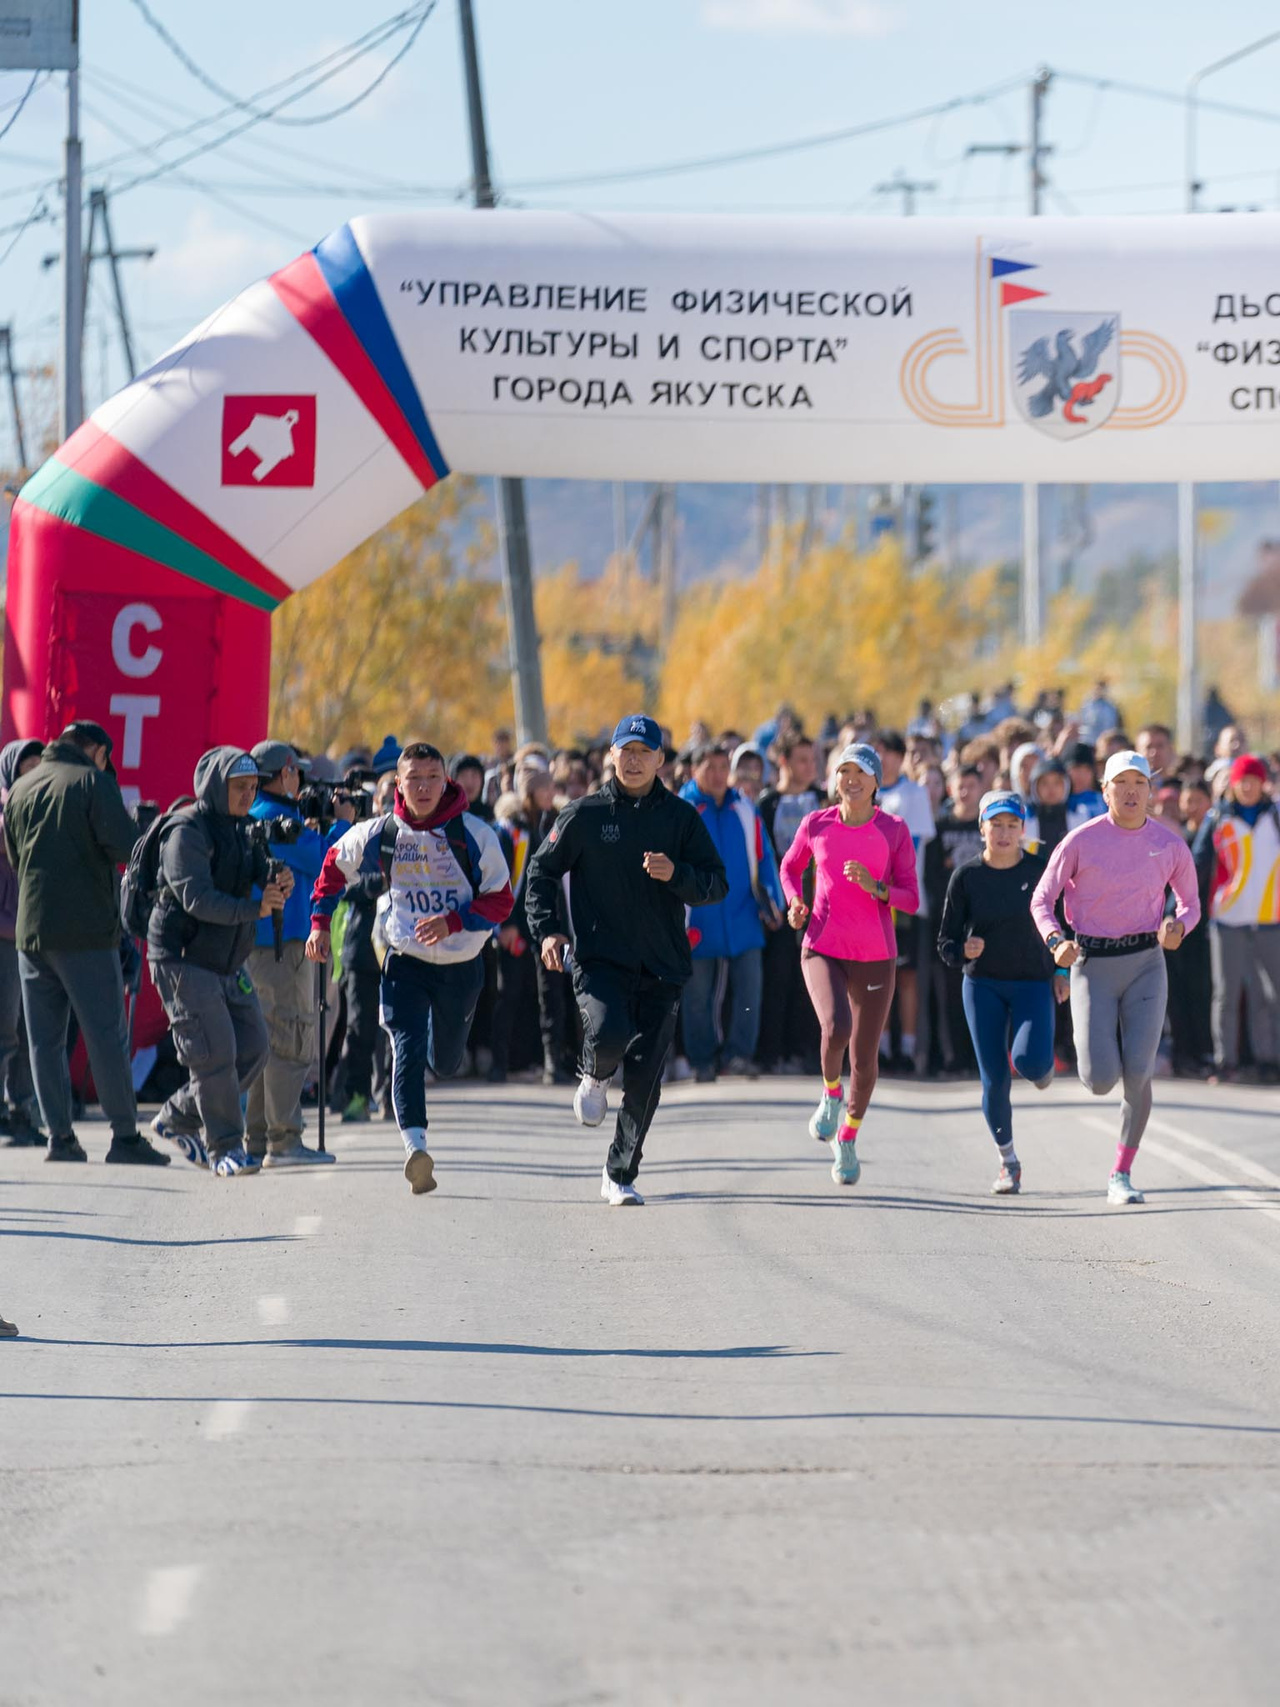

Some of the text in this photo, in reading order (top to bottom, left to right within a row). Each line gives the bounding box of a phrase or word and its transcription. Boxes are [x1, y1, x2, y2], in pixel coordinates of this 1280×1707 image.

[400, 280, 913, 318] “УПРАВЛЕНИЕ ФИЗИЧЕСКОЙ
[459, 327, 847, 364] КУЛЬТУРЫ И СПОРТА”
[492, 376, 814, 409] ГОРОДА ЯКУТСКА
[602, 824, 620, 833] USA
[405, 889, 459, 914] 1035
[1104, 934, 1140, 949] PRO
